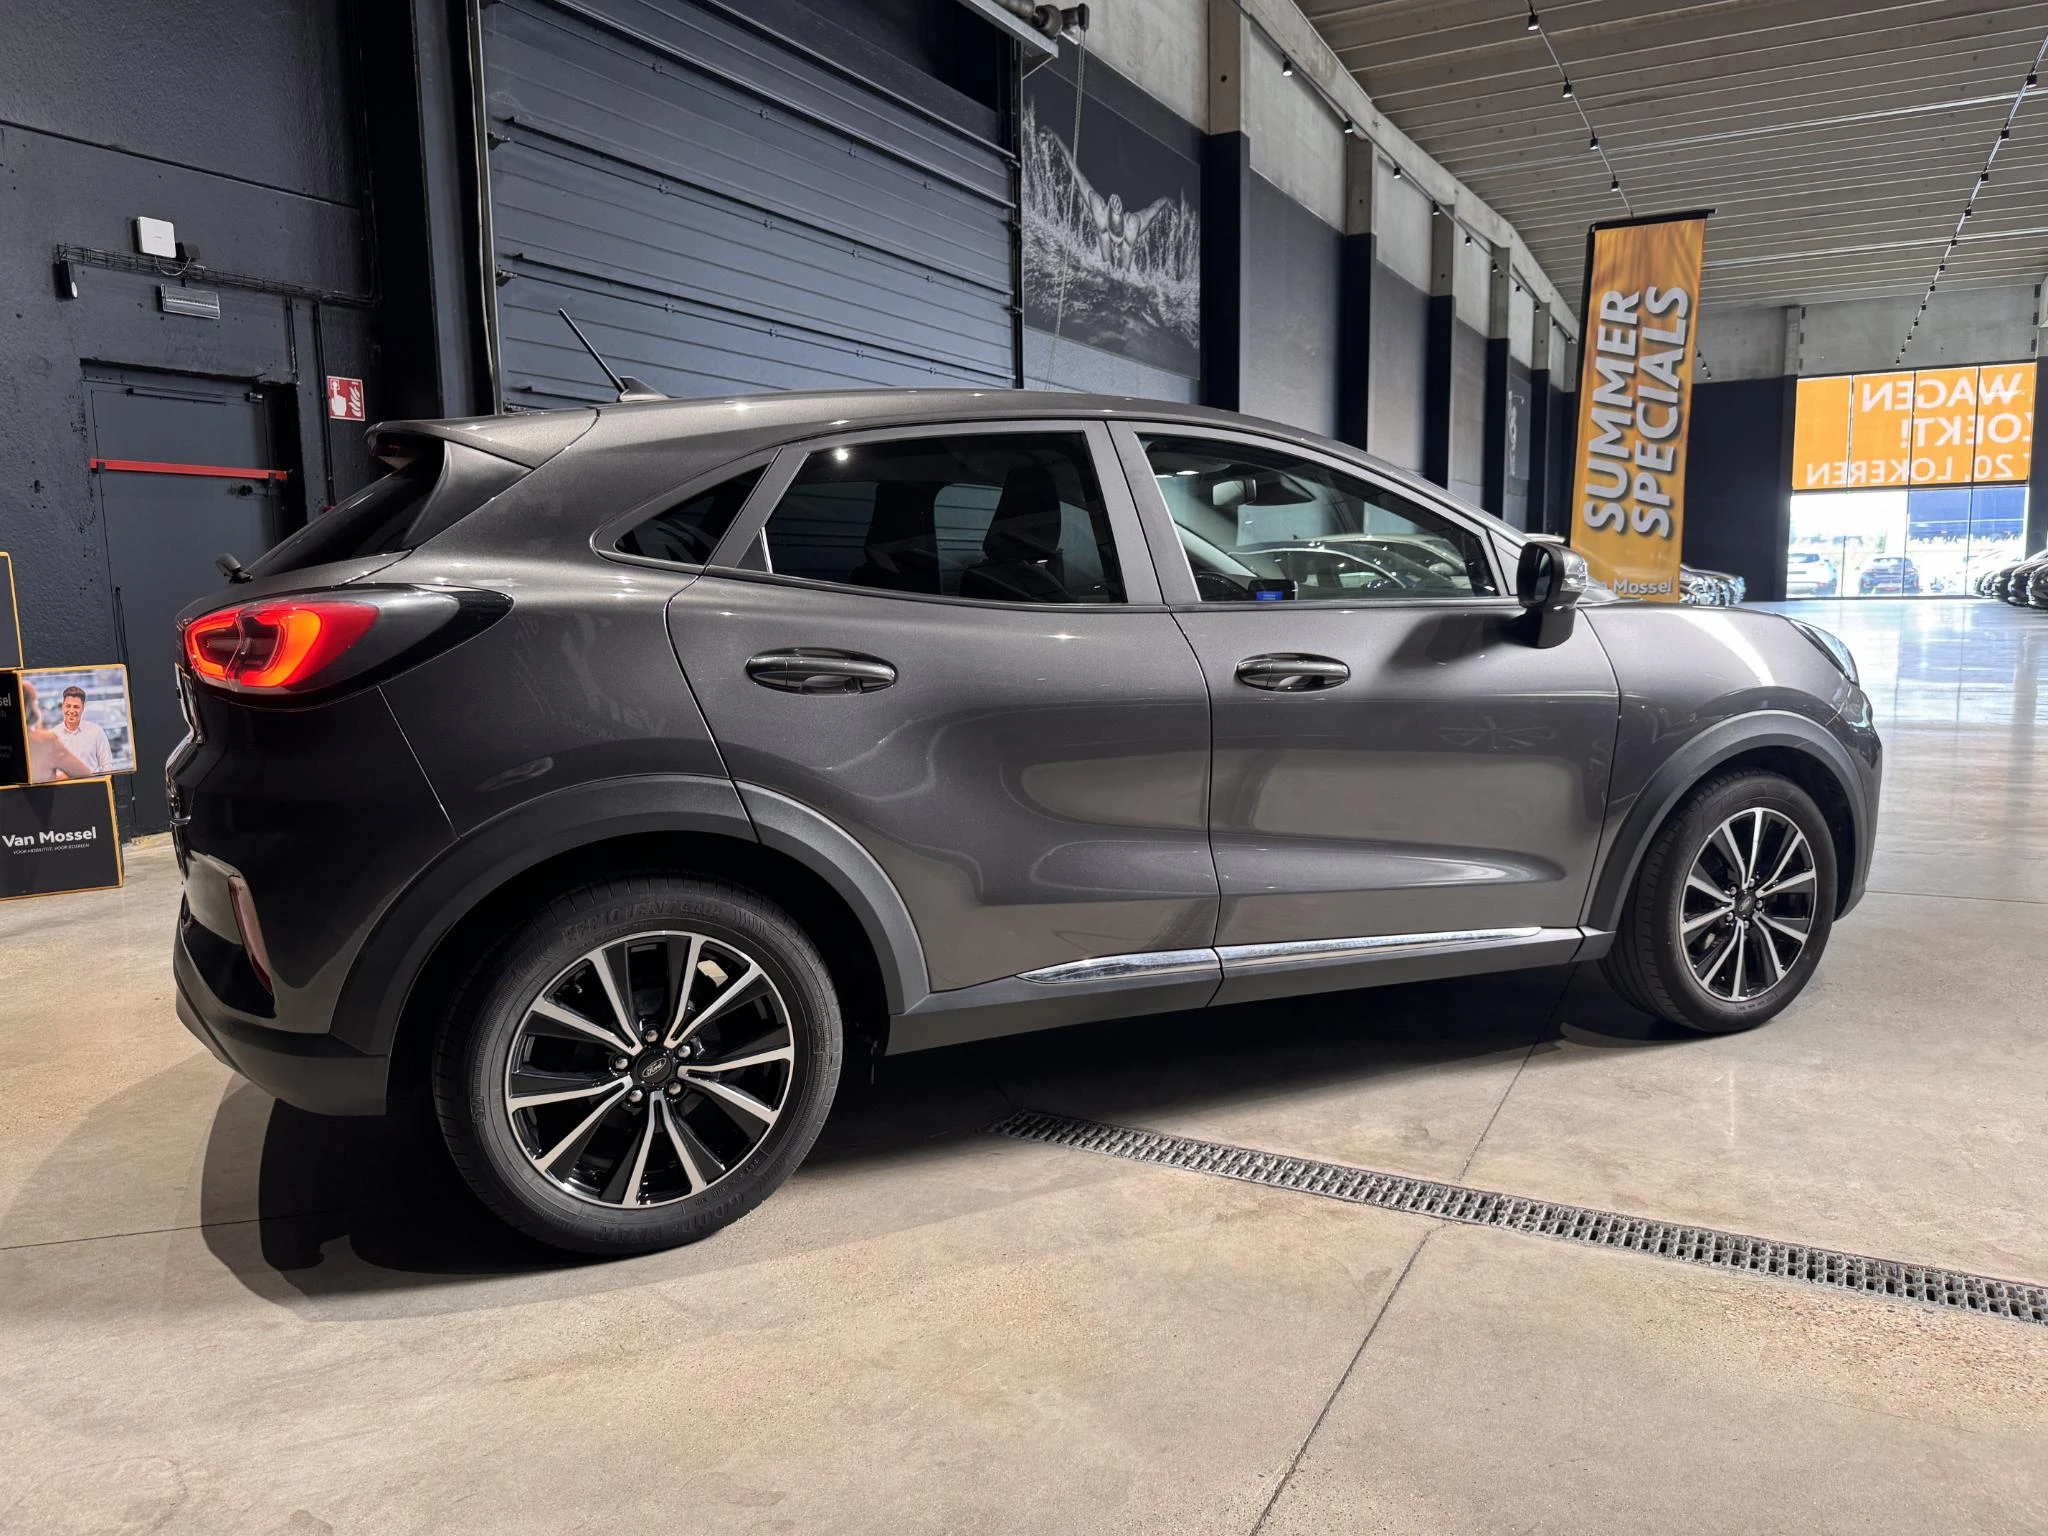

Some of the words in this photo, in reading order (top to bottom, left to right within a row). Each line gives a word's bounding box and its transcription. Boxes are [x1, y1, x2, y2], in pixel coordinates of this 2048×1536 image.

[1583, 290, 1640, 535] SUMMER
[1632, 286, 1690, 539] SPECIALS
[1613, 576, 1674, 595] Mossel
[2, 834, 35, 848] Van
[39, 826, 97, 844] Mossel
